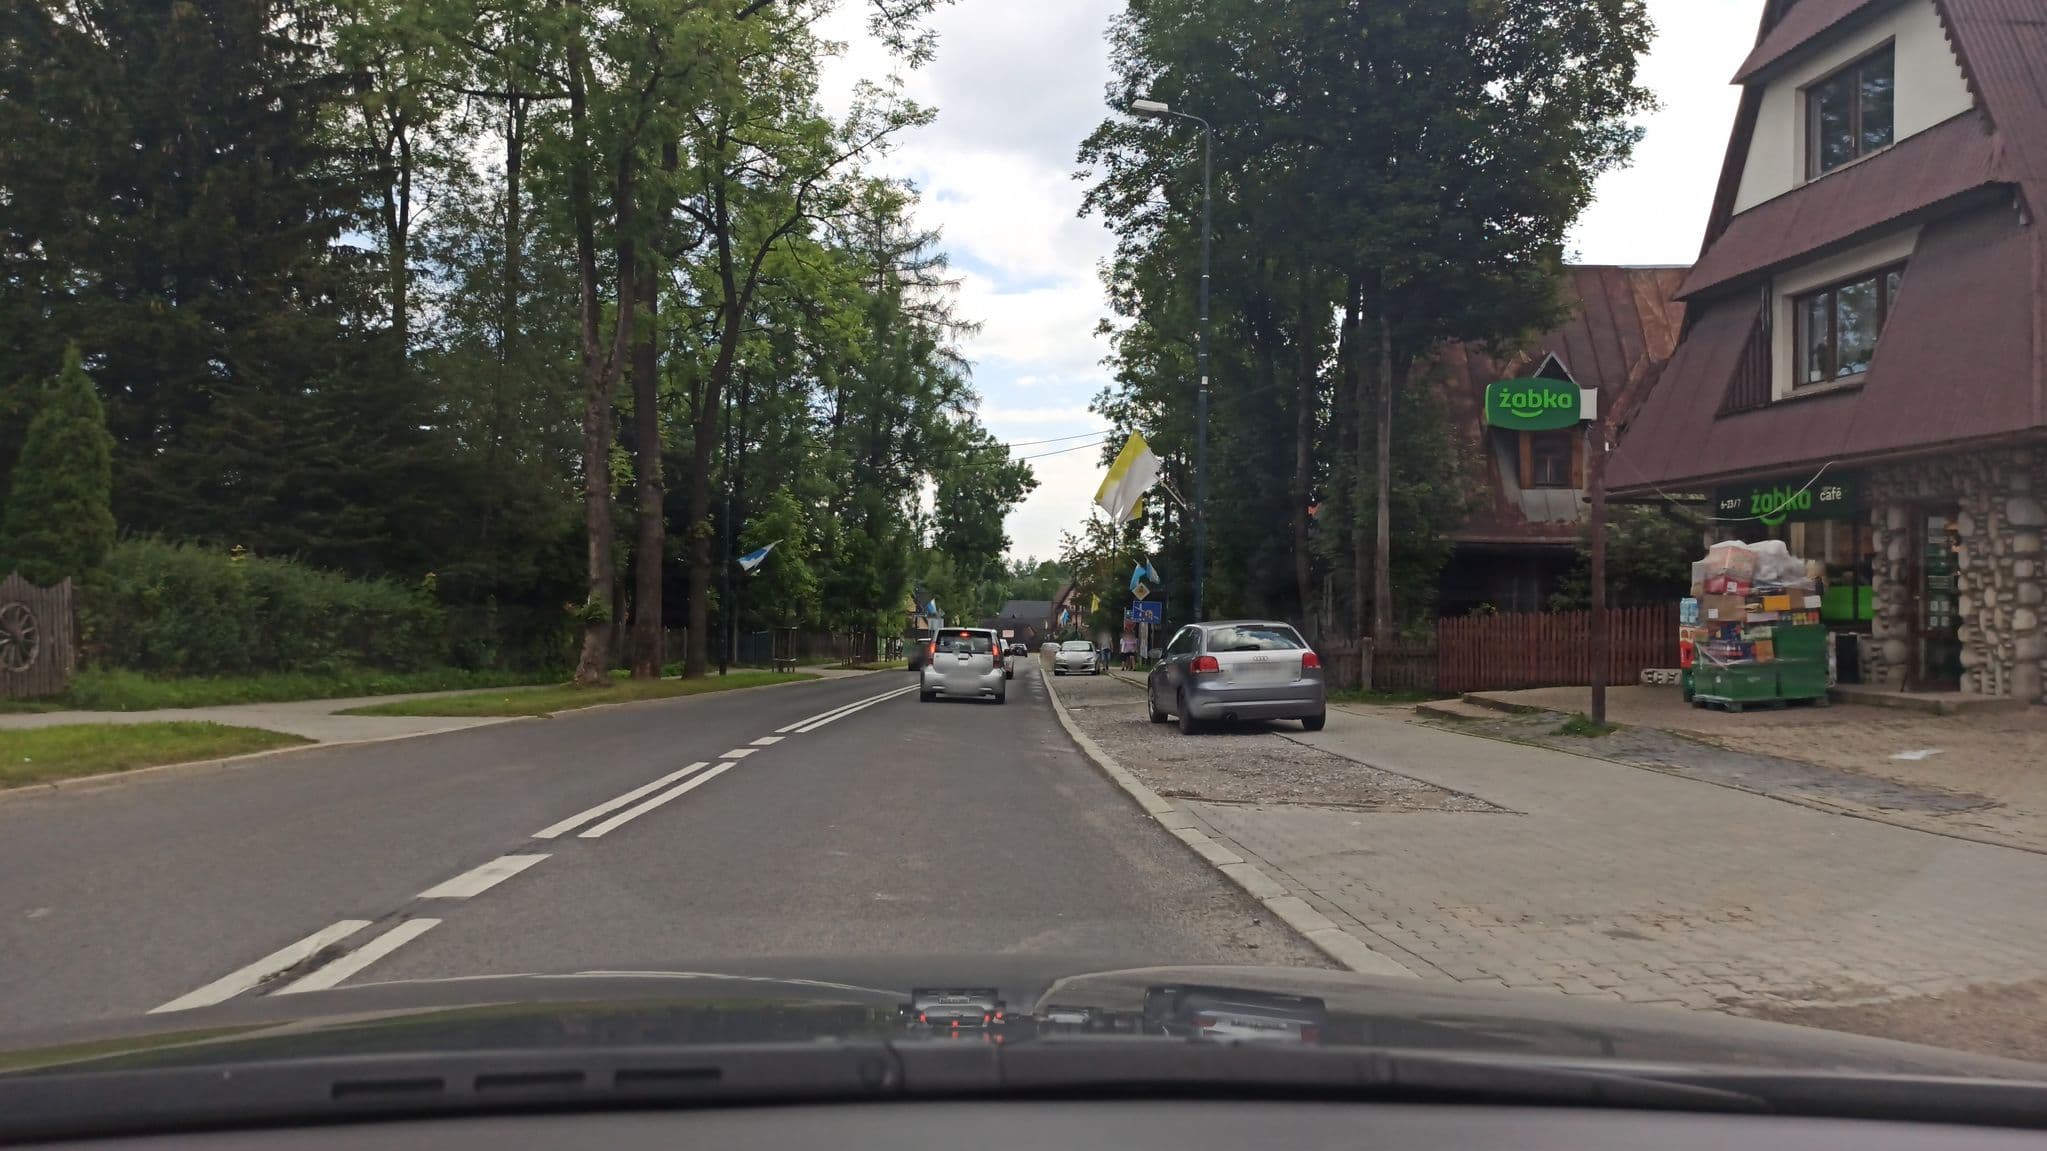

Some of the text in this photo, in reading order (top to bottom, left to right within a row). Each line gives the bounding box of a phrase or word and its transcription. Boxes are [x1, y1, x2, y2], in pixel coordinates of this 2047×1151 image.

[1499, 388, 1573, 408] żabka
[1751, 485, 1811, 513] żabka
[1819, 486, 1842, 501] café
